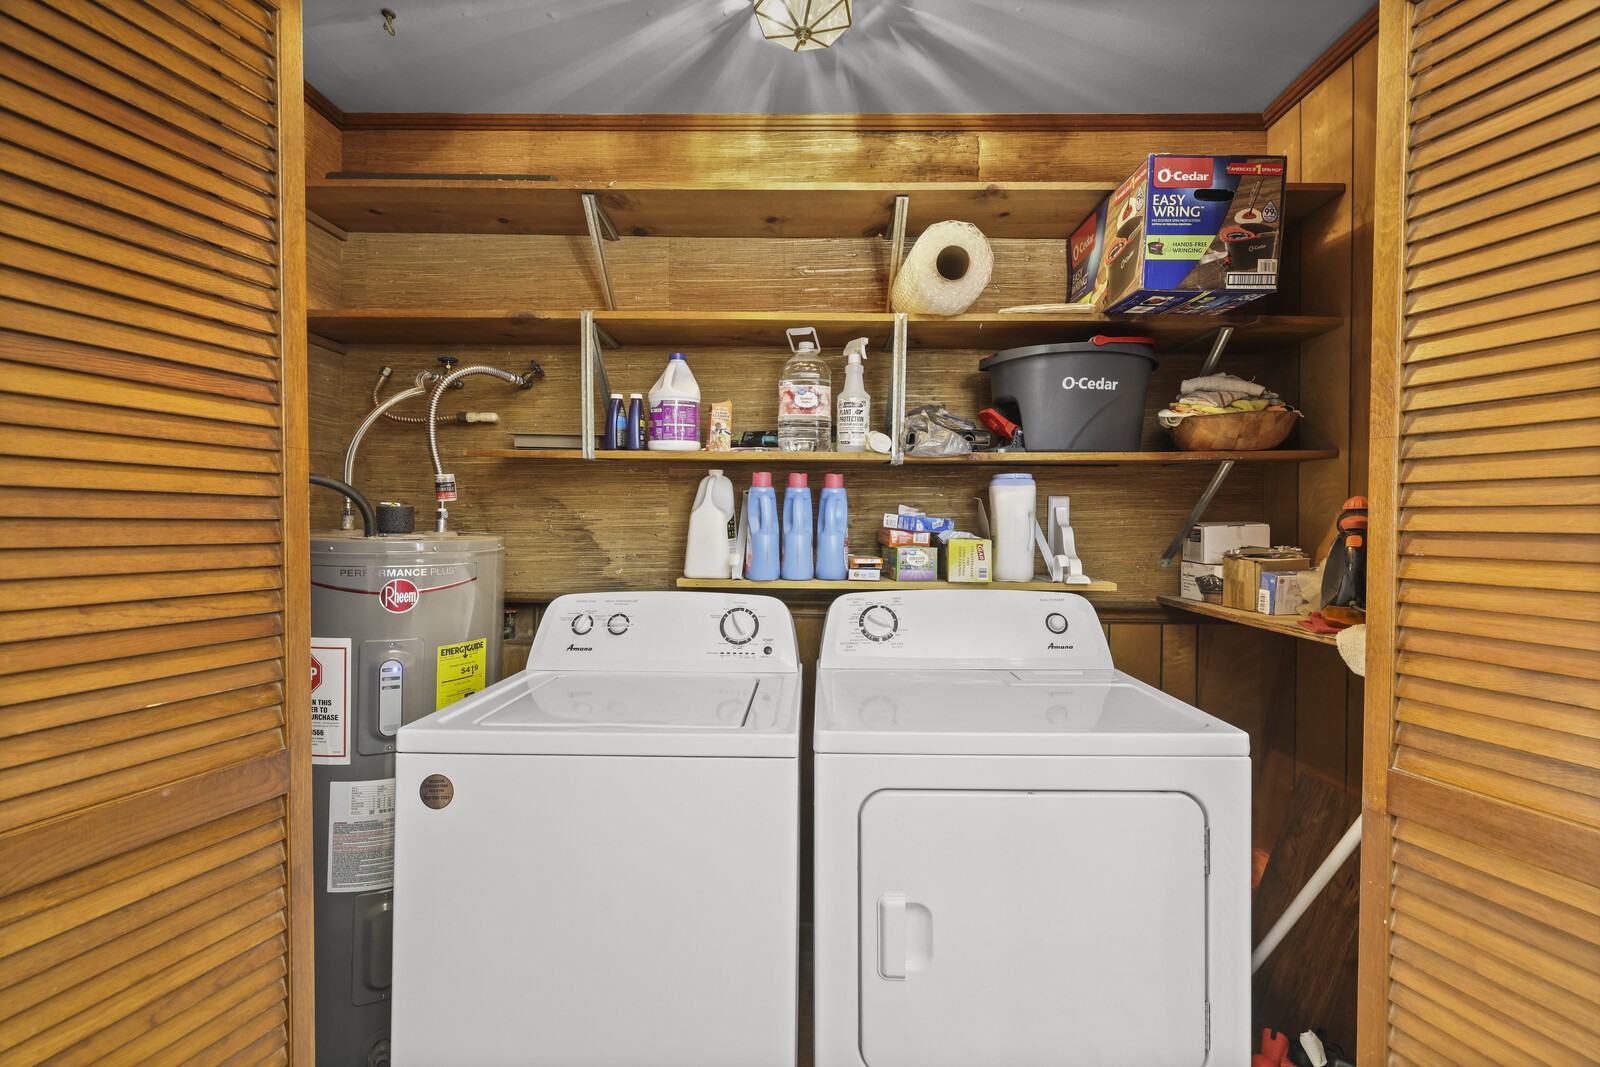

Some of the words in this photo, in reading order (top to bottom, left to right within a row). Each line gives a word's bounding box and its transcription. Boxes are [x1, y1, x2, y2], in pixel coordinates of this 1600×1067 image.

[1157, 168, 1209, 183] O-Cedar
[1153, 194, 1186, 206] EASY
[1062, 376, 1118, 390] O-Cedar
[430, 567, 455, 576] PLUS
[384, 580, 417, 608] Rheem
[566, 644, 593, 652] Amana
[1047, 642, 1074, 650] Amana
